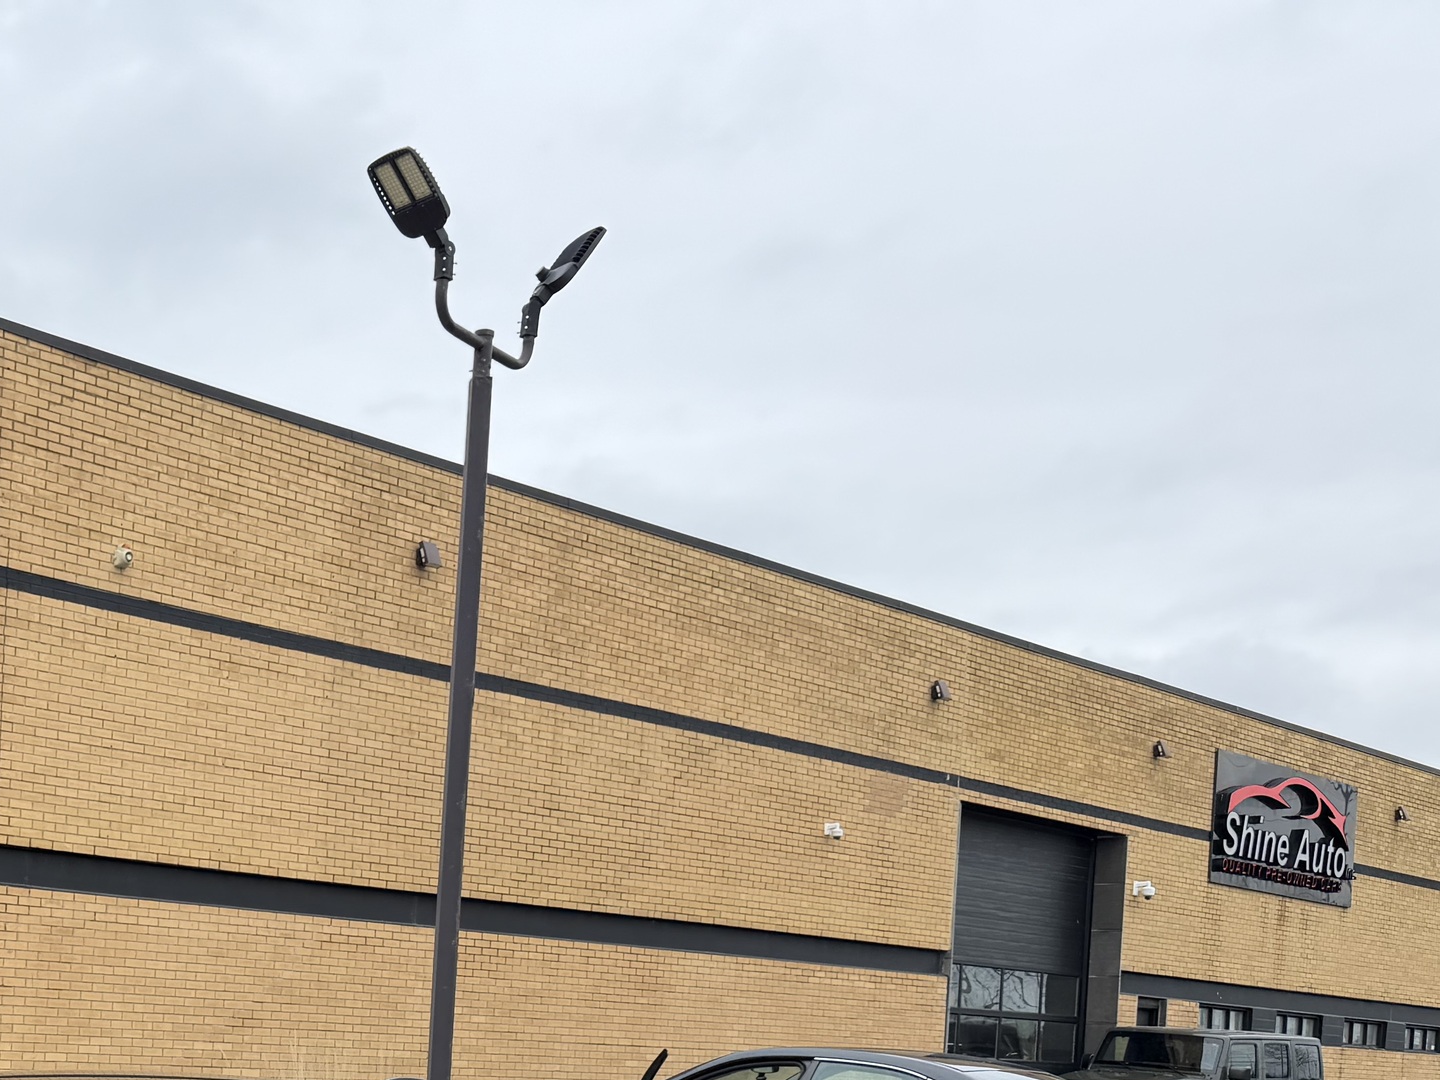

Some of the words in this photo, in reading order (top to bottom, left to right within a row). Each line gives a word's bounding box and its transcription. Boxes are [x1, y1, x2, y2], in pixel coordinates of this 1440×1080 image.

[1222, 811, 1290, 866] Shine
[1293, 829, 1346, 879] Auto
[1222, 857, 1263, 878] QUALITY
[1265, 866, 1318, 888] PRE-OWNED
